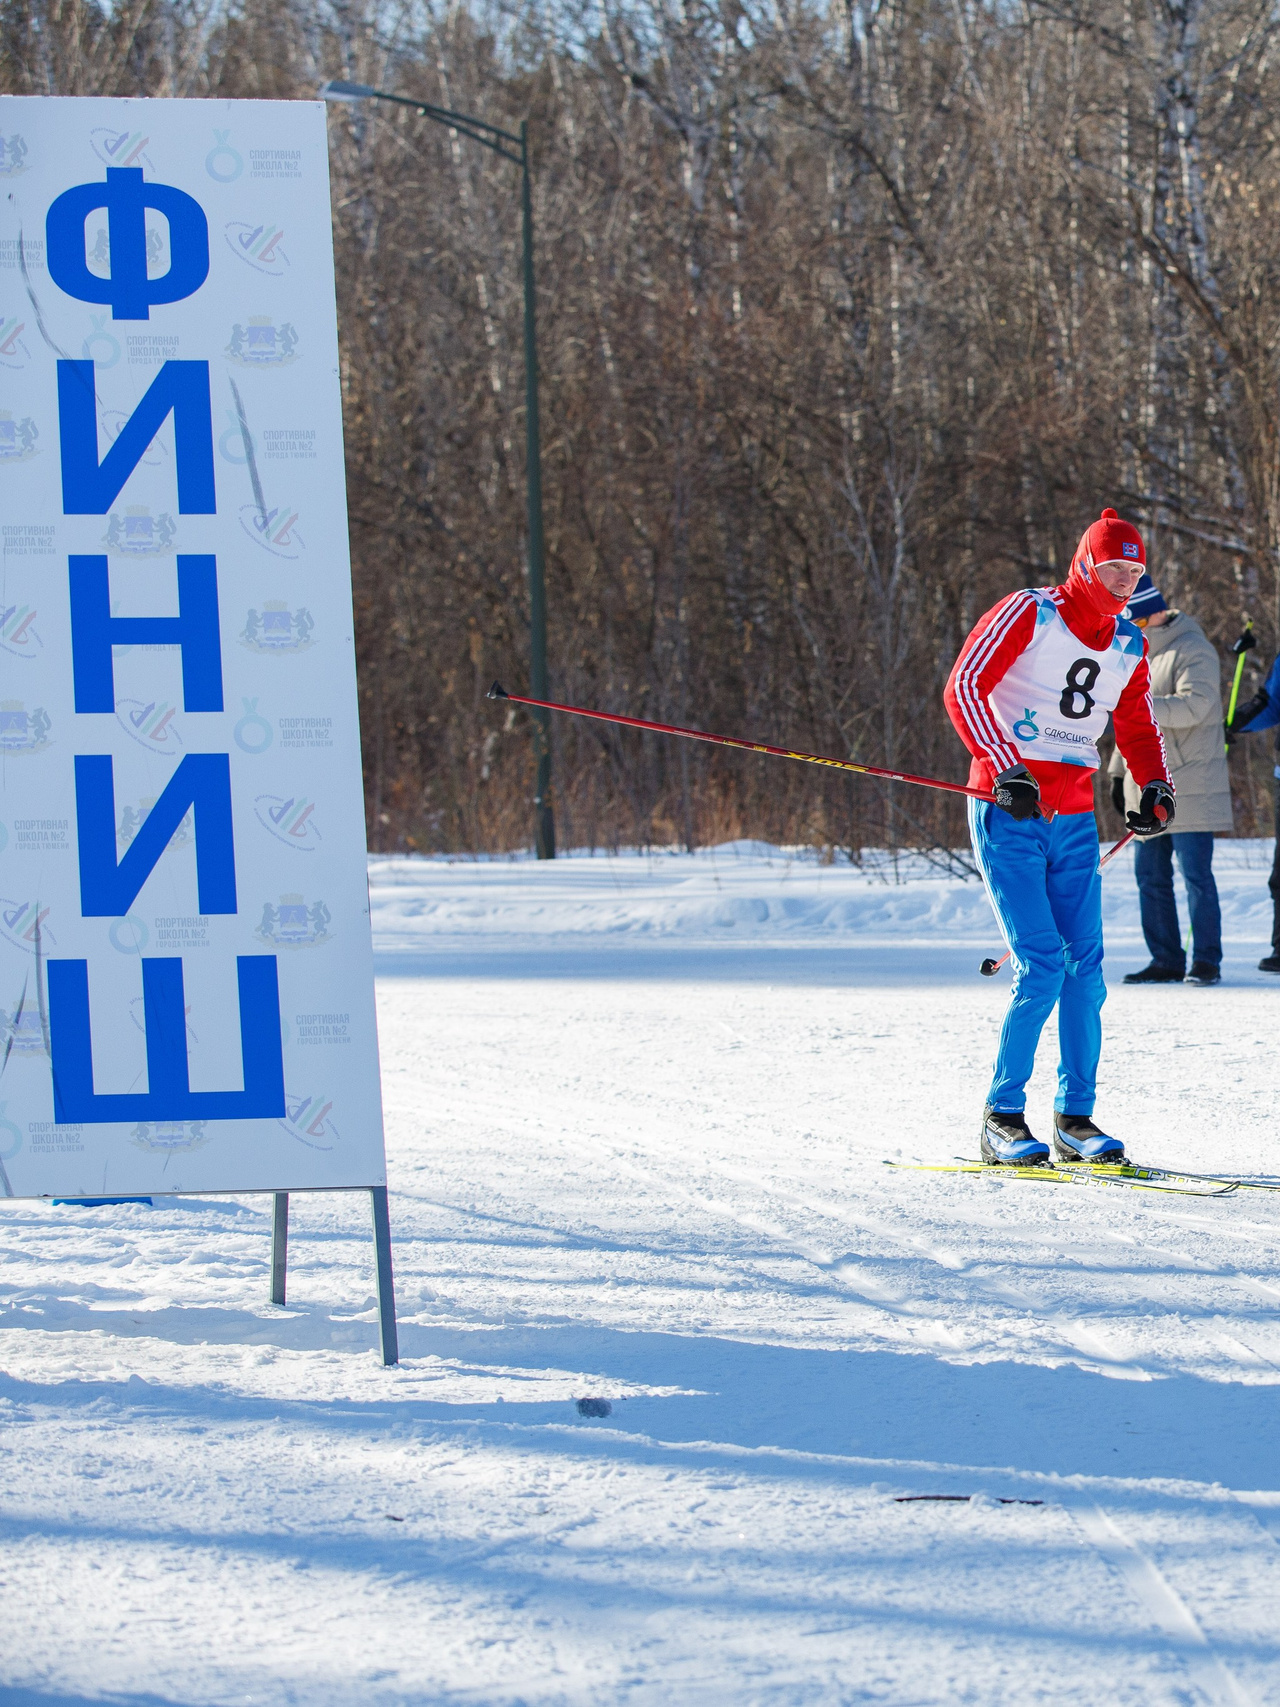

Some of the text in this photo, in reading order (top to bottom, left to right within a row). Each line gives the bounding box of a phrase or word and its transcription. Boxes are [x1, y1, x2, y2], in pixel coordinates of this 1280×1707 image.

[250, 150, 301, 160] СПОРТИВНАЯ
[253, 161, 298, 170] ШКОЛА №2
[127, 336, 179, 346] СПОРТИВНАЯ
[130, 347, 176, 356] ШКОЛА №2
[263, 430, 315, 440] СПОРТИВНАЯ
[267, 442, 313, 450] ШКОЛА №2
[2, 526, 55, 535] СПОРТИВНАЯ
[5, 537, 52, 547] ШКОЛА №2
[46, 167, 286, 1124] ФИНИШ
[1059, 657, 1101, 719] 8
[279, 718, 332, 728] СПОРТИВНАЯ
[283, 729, 329, 739] ШКОЛА №2
[280, 740, 304, 748] ГОРОДА
[14, 820, 68, 830] СПОРТИВНАЯ
[18, 831, 65, 841] ШКОЛА №2
[155, 917, 208, 928] СПОРТИВНАЯ
[158, 929, 206, 939] ШКОЛА №2
[296, 1014, 349, 1025] СПОРТИВНАЯ
[300, 1026, 347, 1036] ШКОЛА №2
[297, 1037, 322, 1045] ГОРОДА
[32, 1134, 80, 1144] ШКОЛА №2
